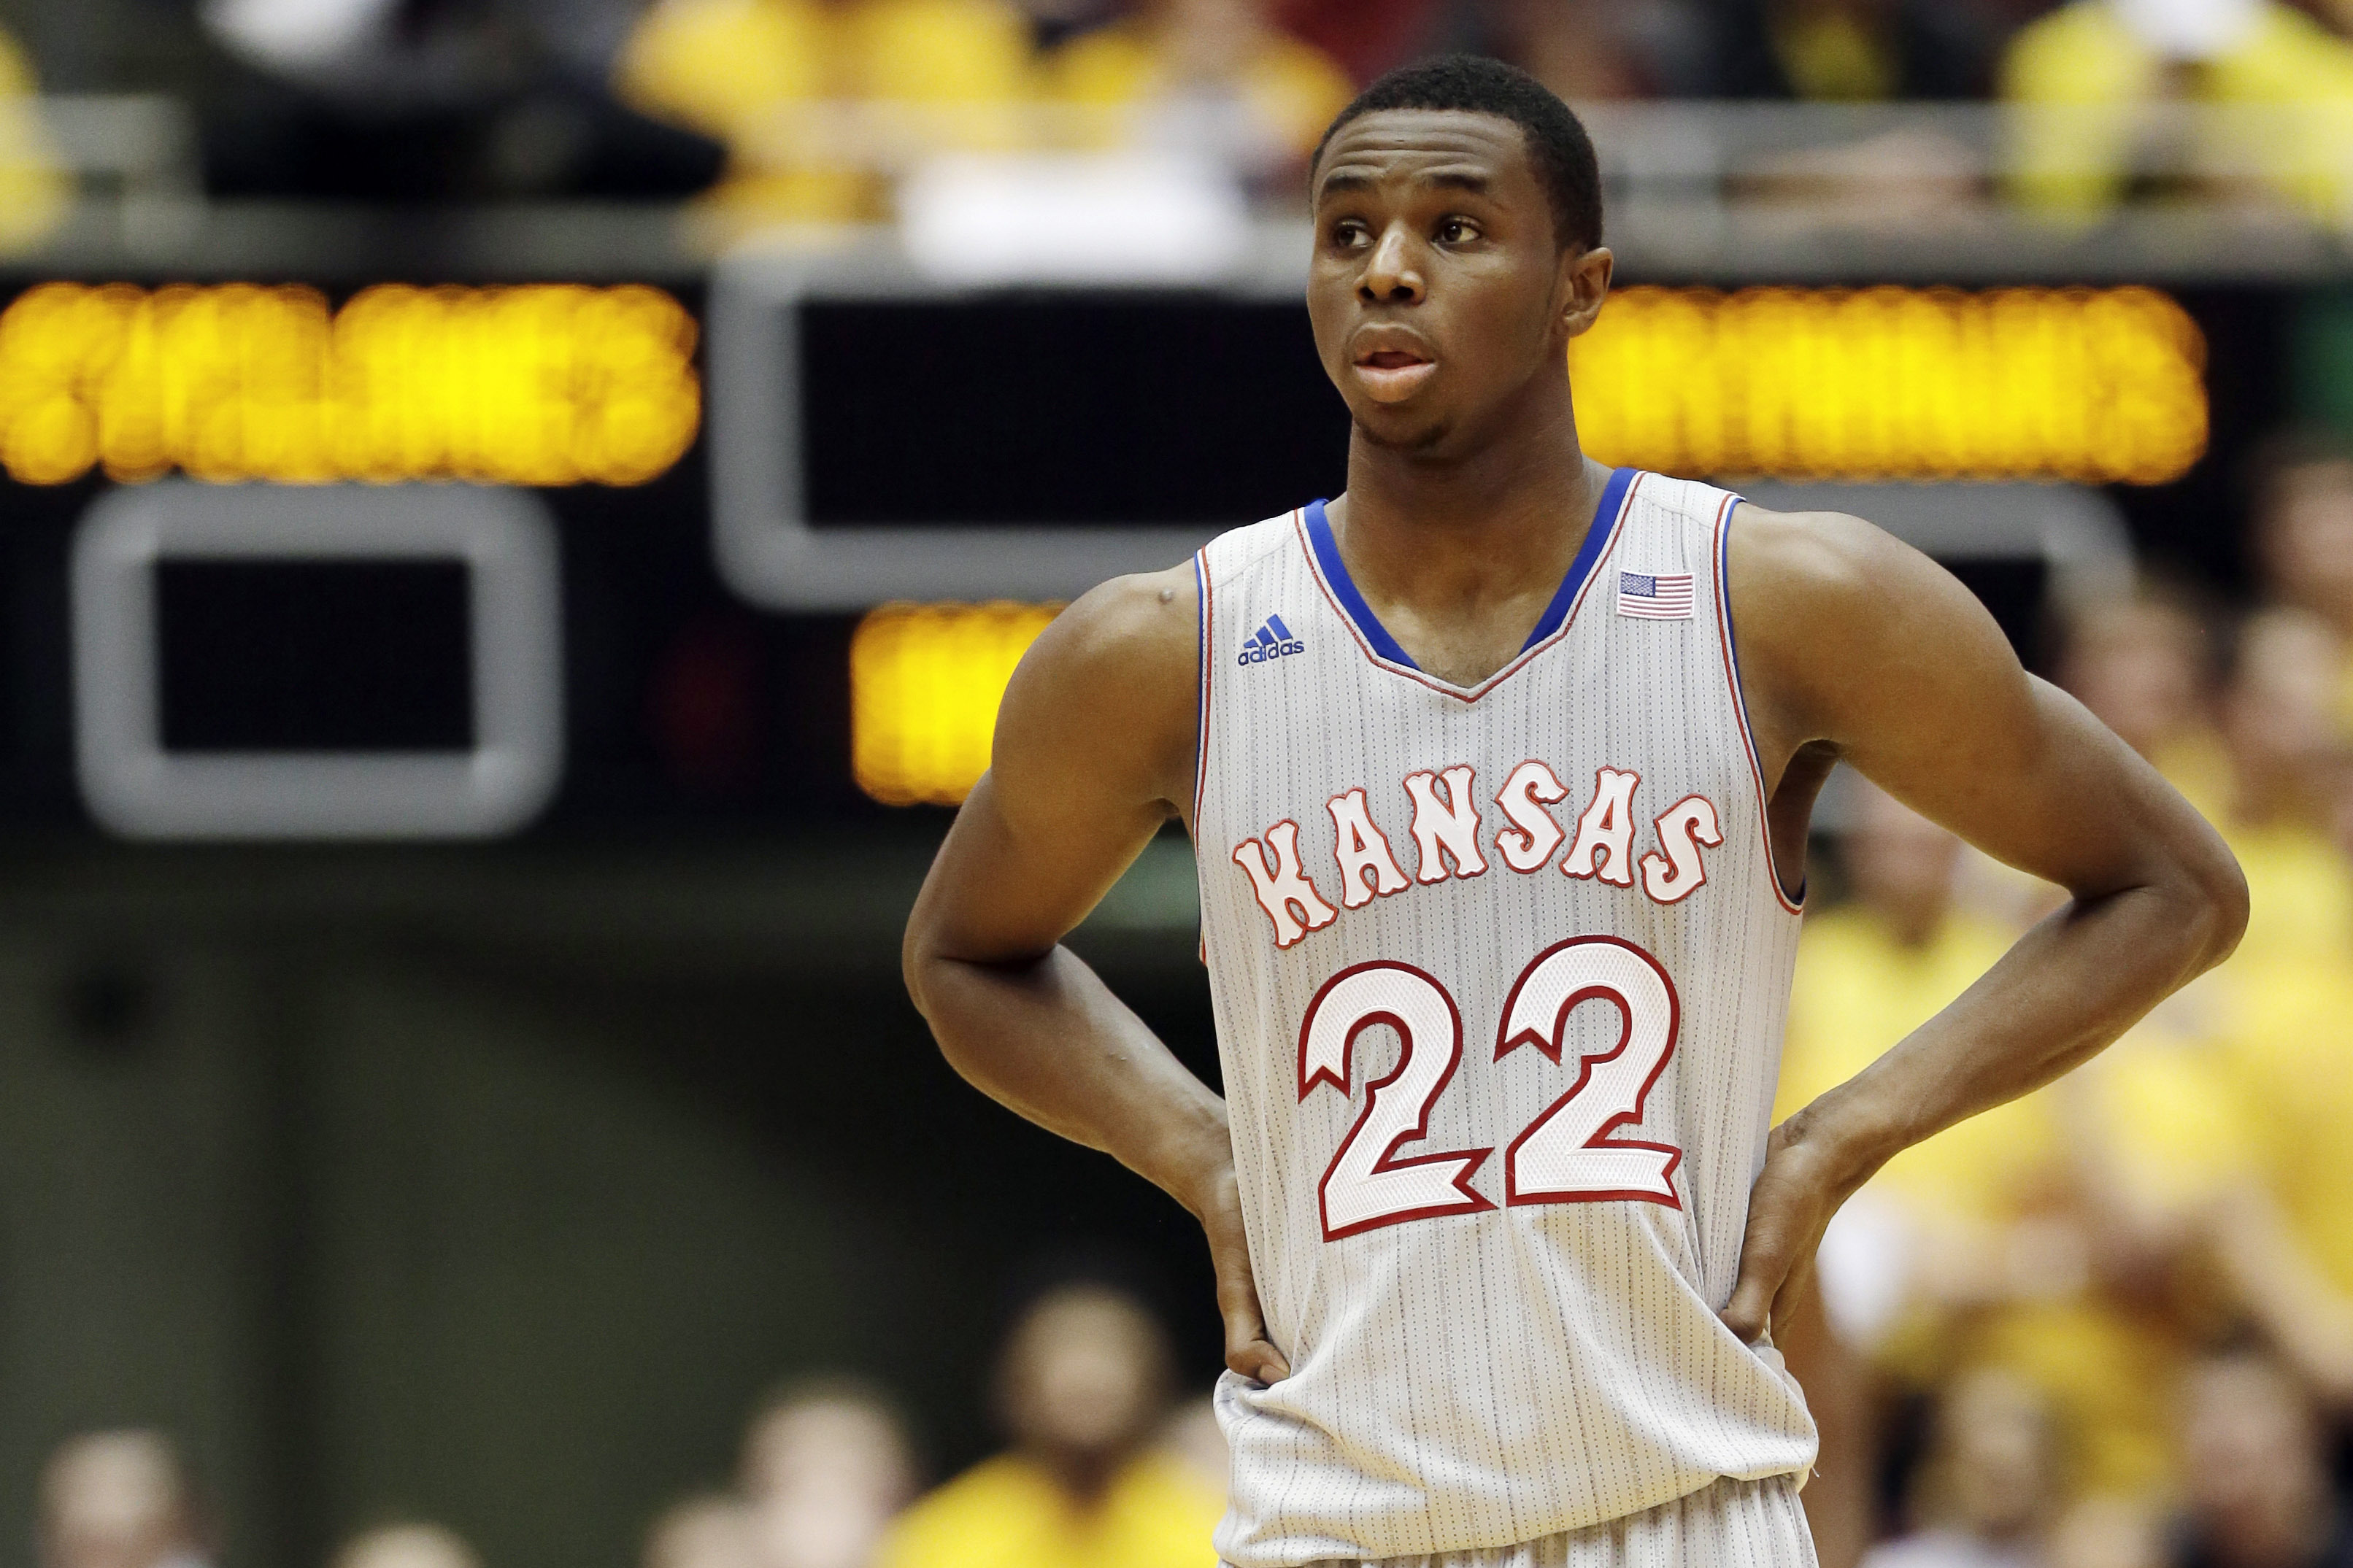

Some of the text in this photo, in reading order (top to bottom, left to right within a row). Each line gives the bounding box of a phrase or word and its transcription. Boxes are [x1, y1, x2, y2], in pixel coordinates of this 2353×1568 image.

[1237, 641, 1305, 666] adidas
[1232, 759, 1725, 949] KANSAS
[1297, 934, 1683, 1243] 22
